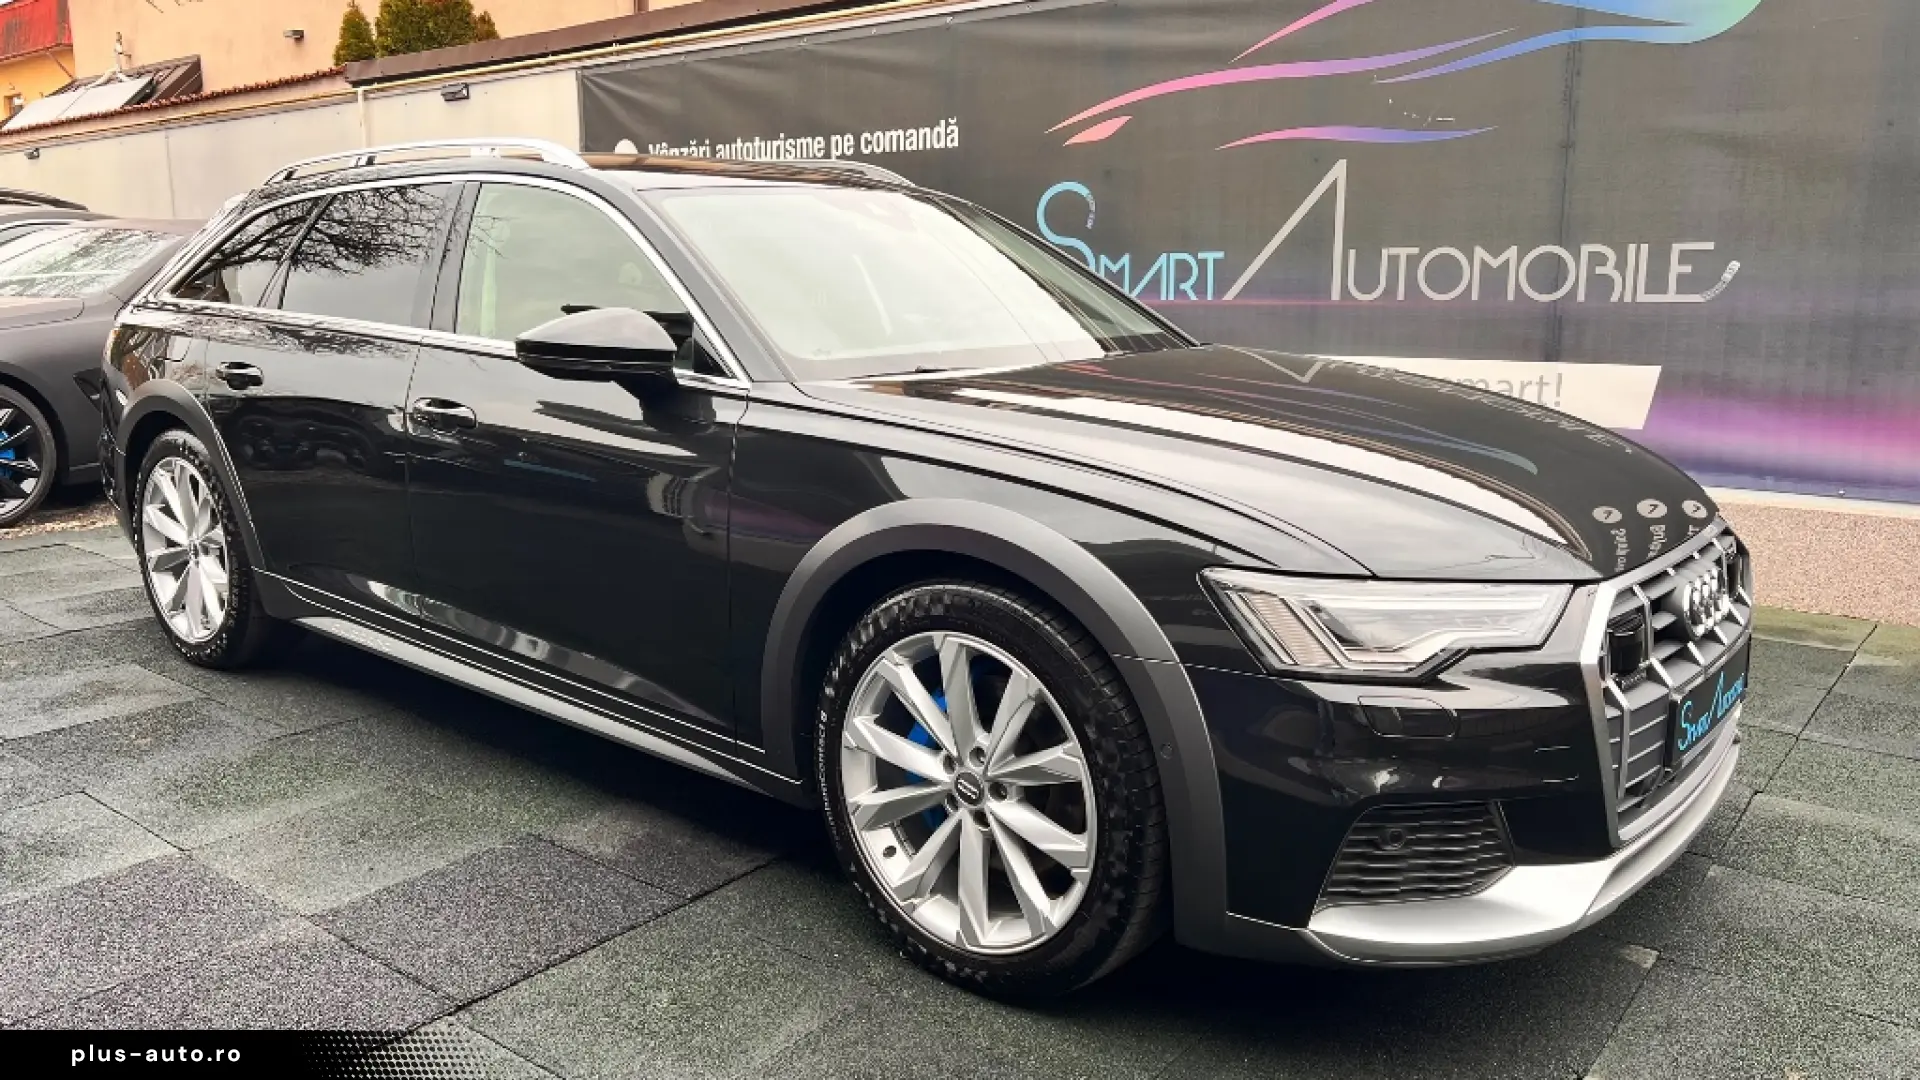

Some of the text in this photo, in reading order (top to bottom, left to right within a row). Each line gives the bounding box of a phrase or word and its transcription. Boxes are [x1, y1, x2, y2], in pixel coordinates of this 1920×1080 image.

[715, 132, 826, 162] autoturisme
[830, 132, 854, 161] pe
[860, 116, 959, 155] comandă
